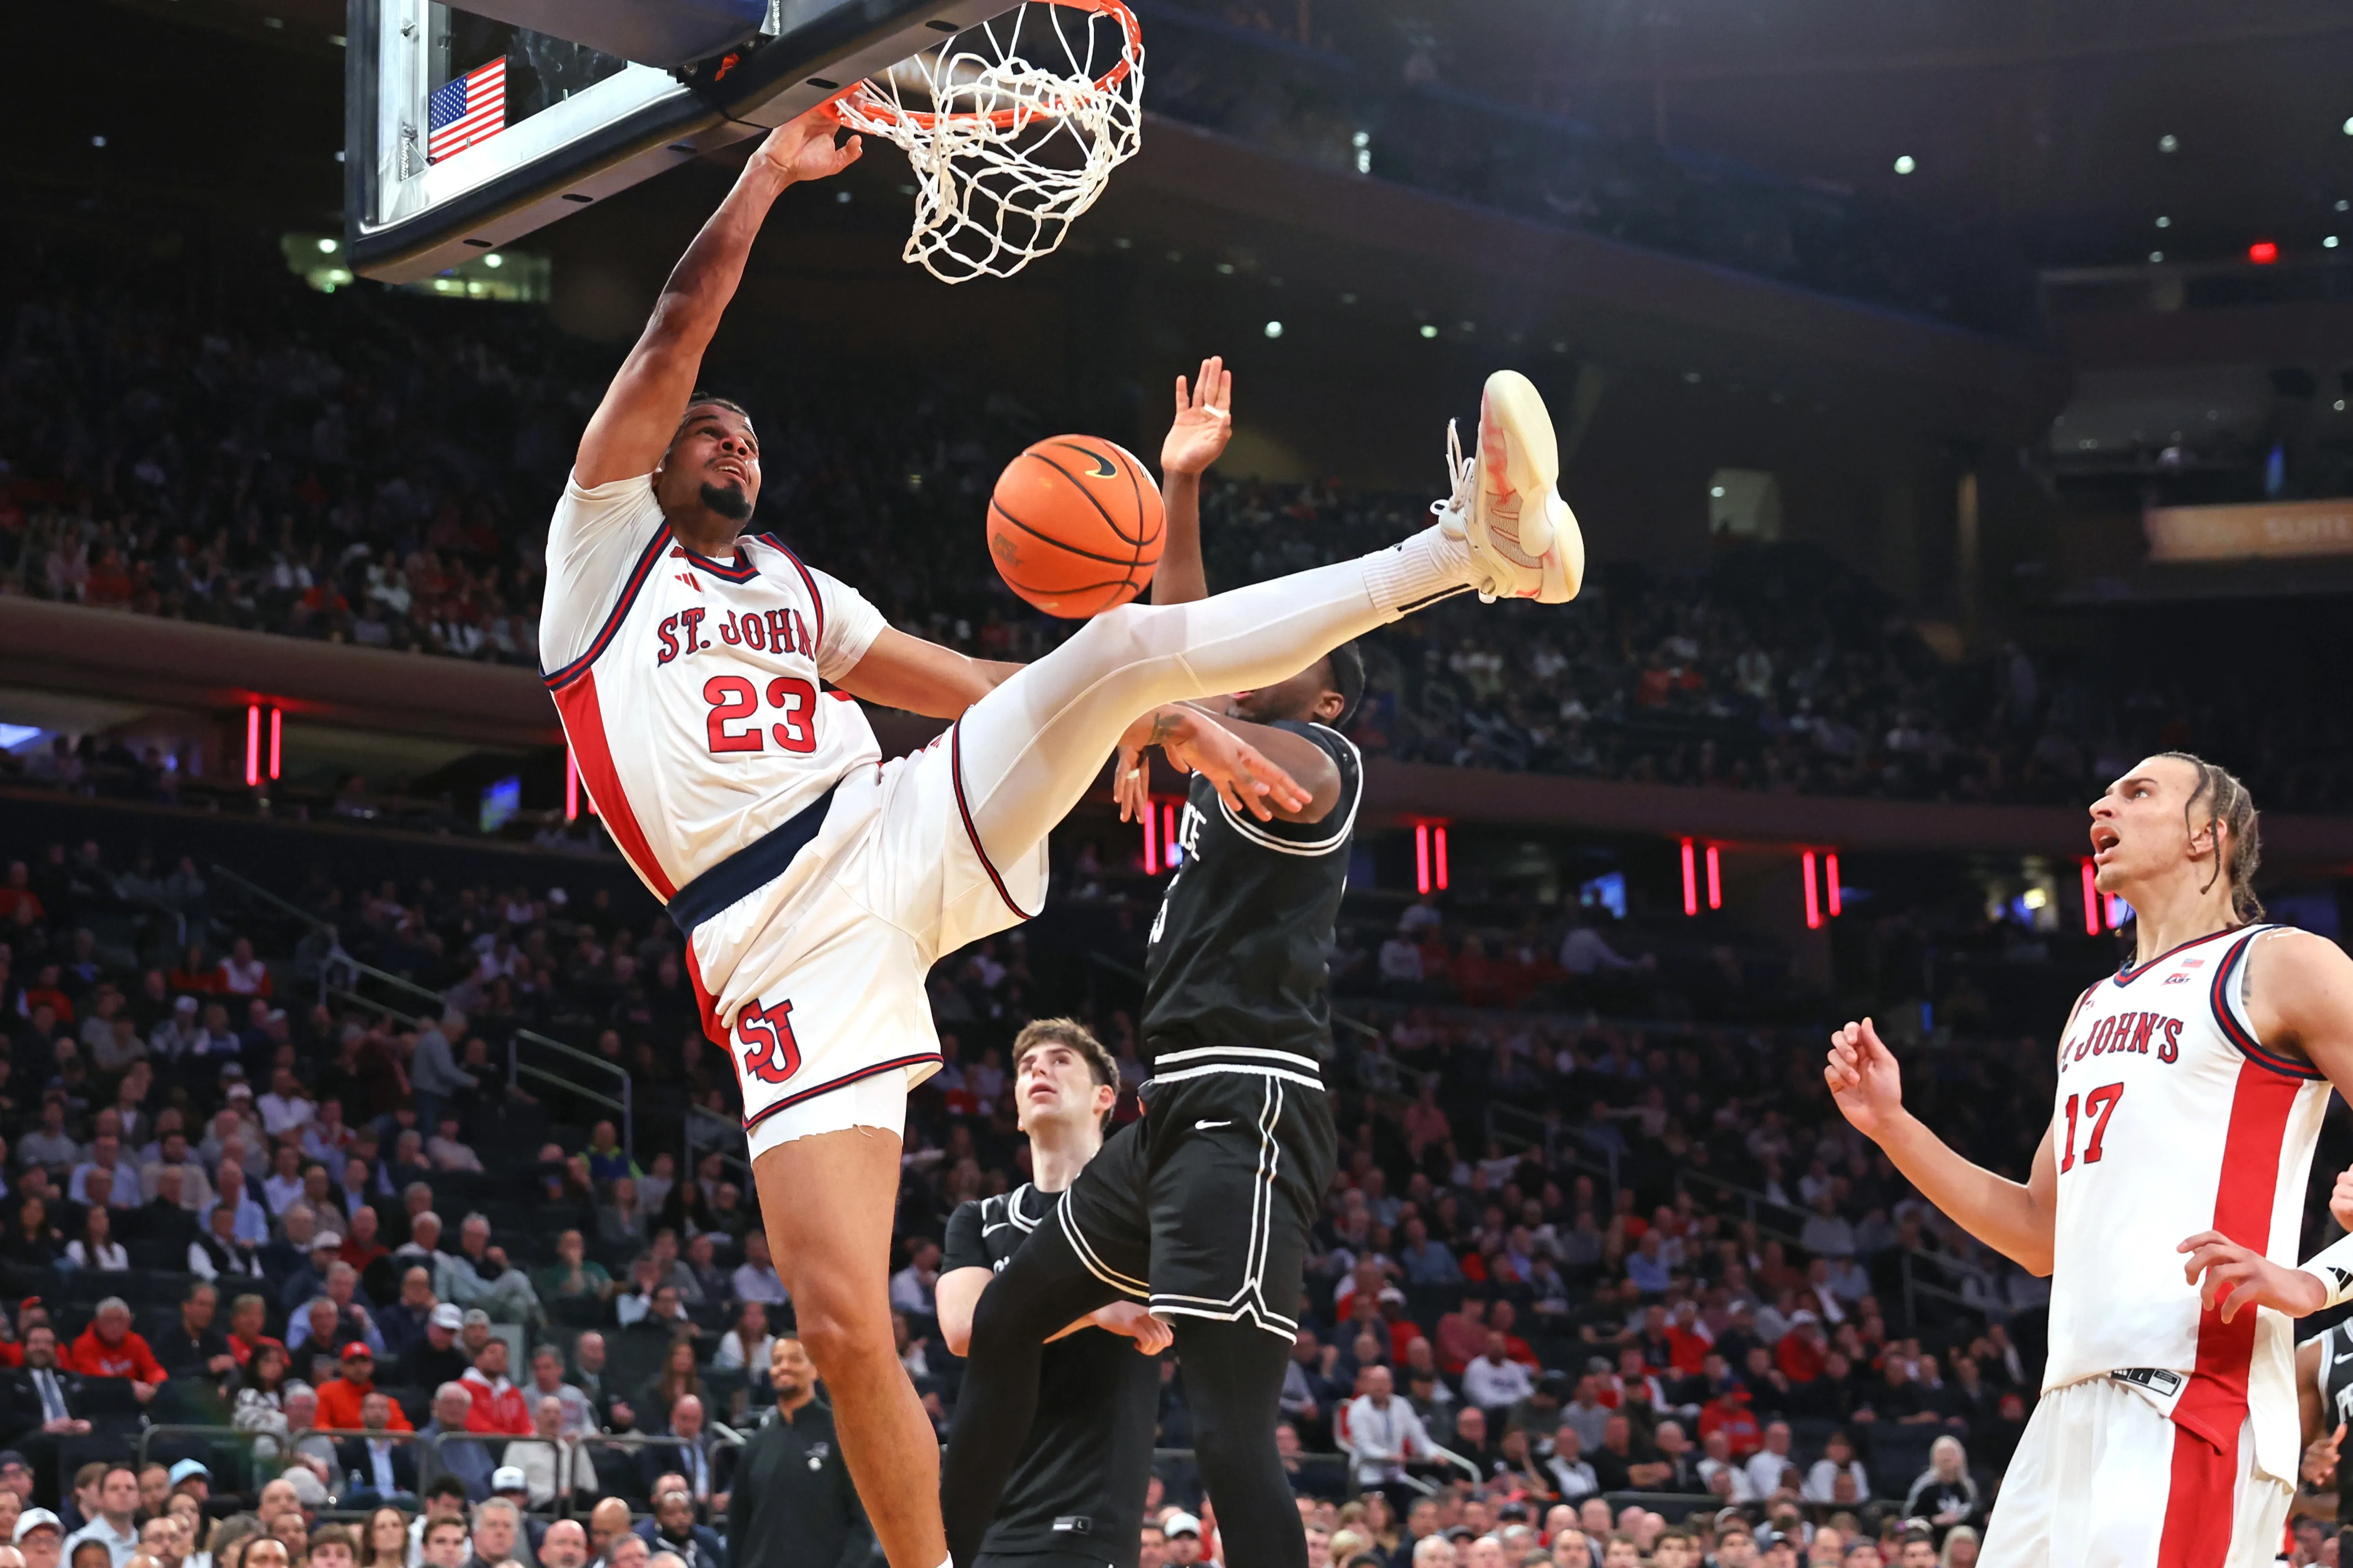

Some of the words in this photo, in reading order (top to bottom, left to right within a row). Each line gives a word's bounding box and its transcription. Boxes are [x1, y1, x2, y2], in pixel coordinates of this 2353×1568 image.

[657, 607, 711, 668] ST.
[703, 675, 817, 753] 23
[2074, 1012, 2184, 1064] JOHN'S
[2060, 1082, 2124, 1175] 17
